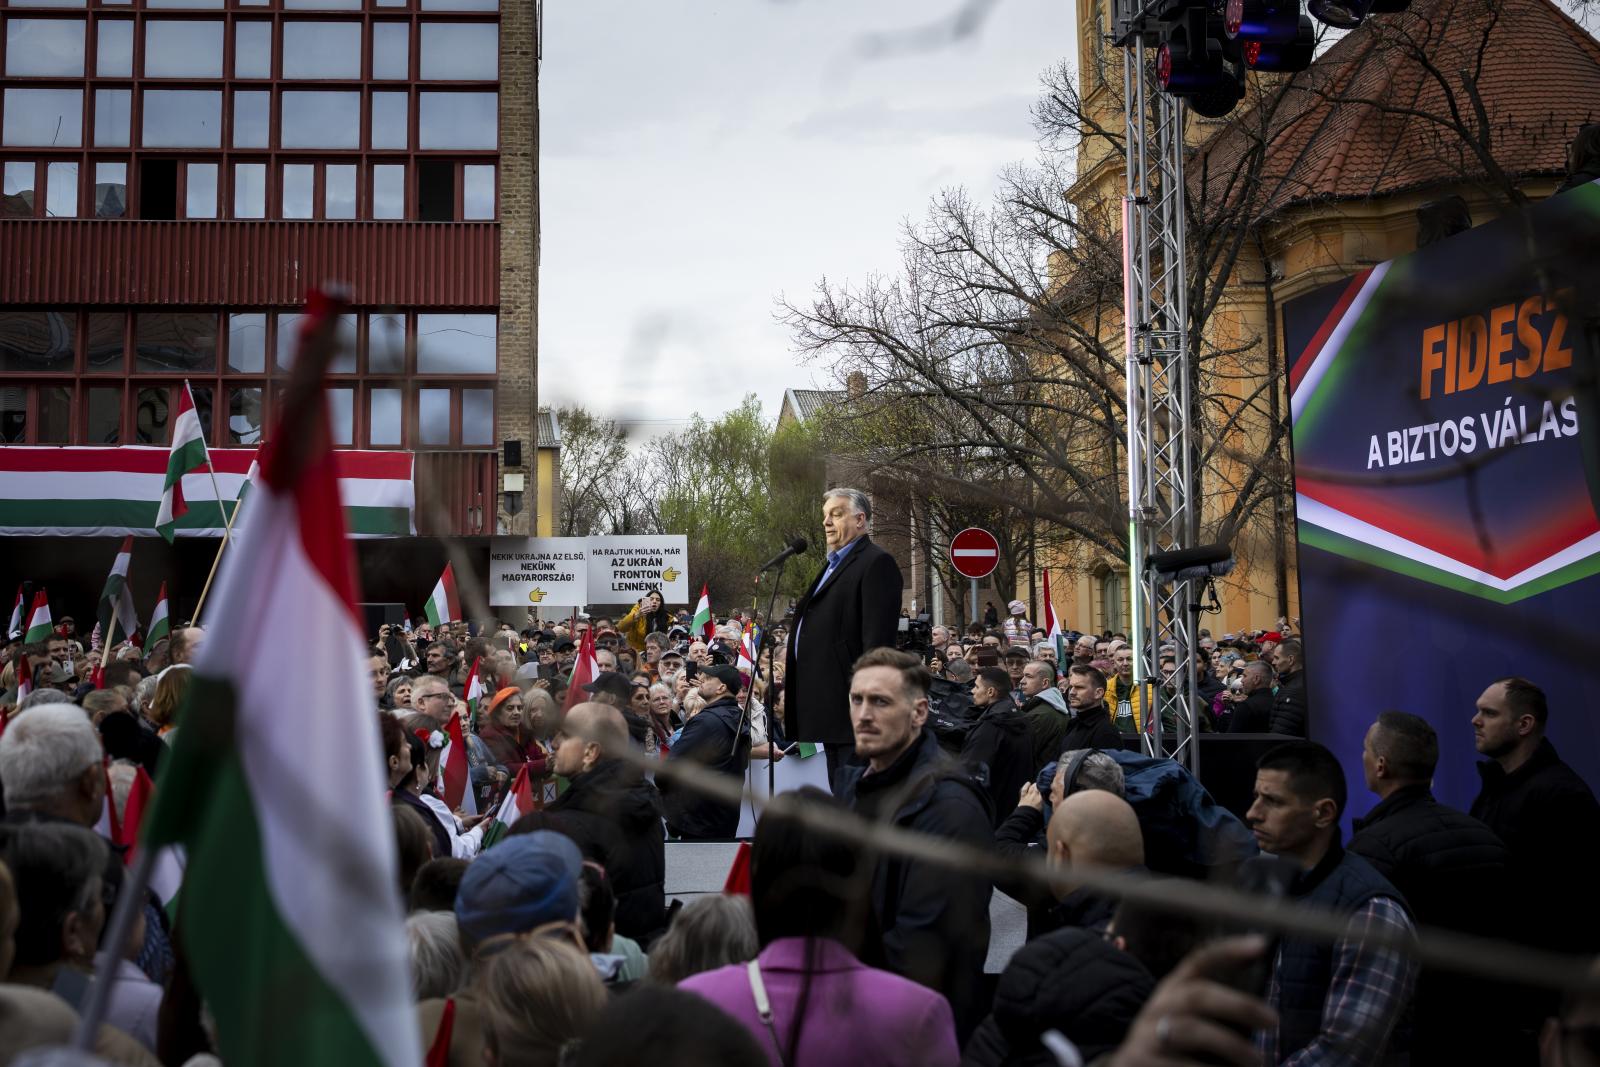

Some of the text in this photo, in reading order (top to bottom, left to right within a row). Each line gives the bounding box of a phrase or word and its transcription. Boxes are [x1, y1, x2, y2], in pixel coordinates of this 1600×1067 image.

[1420, 289, 1573, 400] FIDESZ
[1367, 396, 1580, 469] A BIZTOS VÁLAS
[665, 547, 681, 555] MÁR
[564, 552, 586, 561] ELSŐ,
[611, 556, 663, 567] AZ UKRÁN
[520, 561, 556, 571] NEKÜNK
[502, 572, 575, 581] MAGYARORSZÁG!
[613, 570, 661, 579] FRONTON
[611, 581, 663, 591] LENNÉNK!
